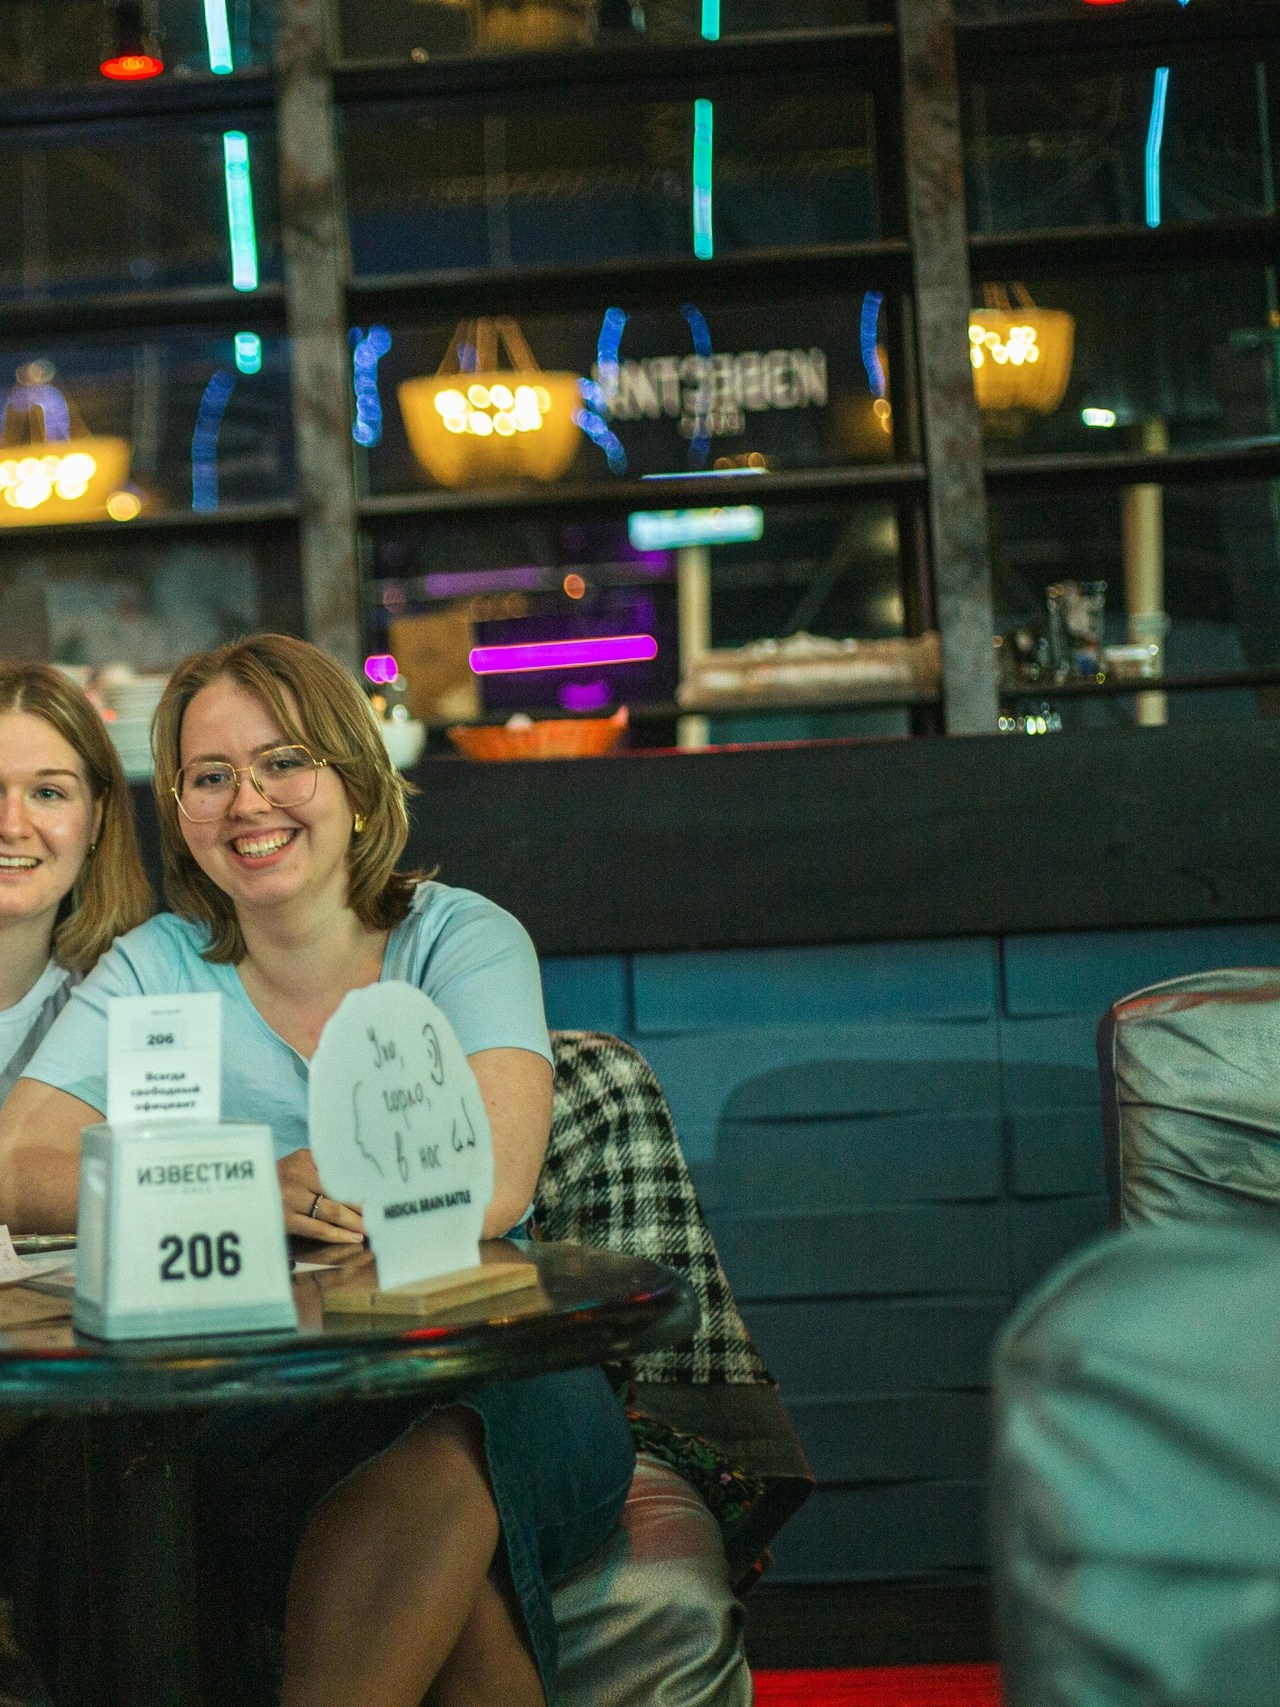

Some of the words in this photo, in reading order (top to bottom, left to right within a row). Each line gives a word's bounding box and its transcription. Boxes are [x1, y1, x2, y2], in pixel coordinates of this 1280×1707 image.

[147, 1033, 174, 1046] 206
[137, 1159, 255, 1186] ИЗВЕСТИЯ
[419, 1195, 445, 1212] BRAIN
[445, 1189, 471, 1207] BATTLE
[159, 1229, 242, 1281] 206
